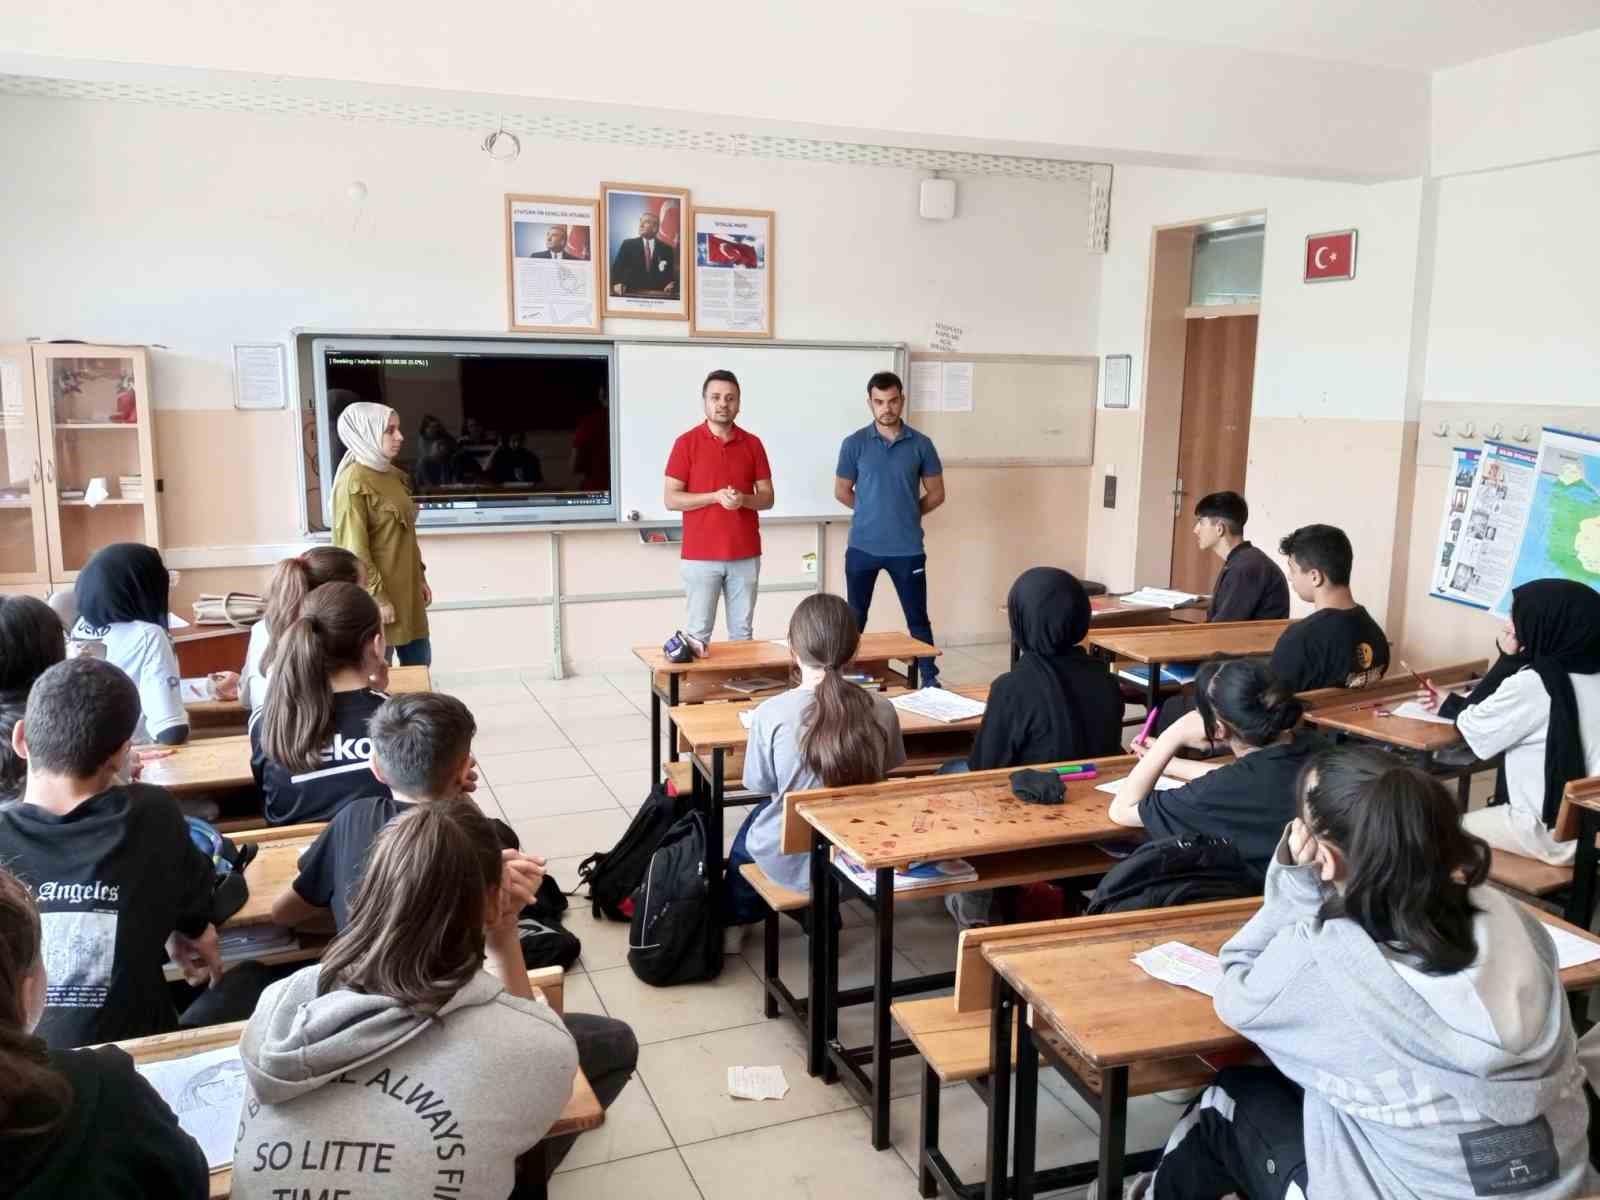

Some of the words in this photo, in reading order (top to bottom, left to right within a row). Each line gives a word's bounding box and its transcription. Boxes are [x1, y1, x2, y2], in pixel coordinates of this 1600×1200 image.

[319, 733, 374, 762] eko
[36, 880, 120, 904] Angeles
[365, 1068, 465, 1161] ALWAYS
[253, 1141, 292, 1172] SO
[301, 1140, 395, 1173] LITTE
